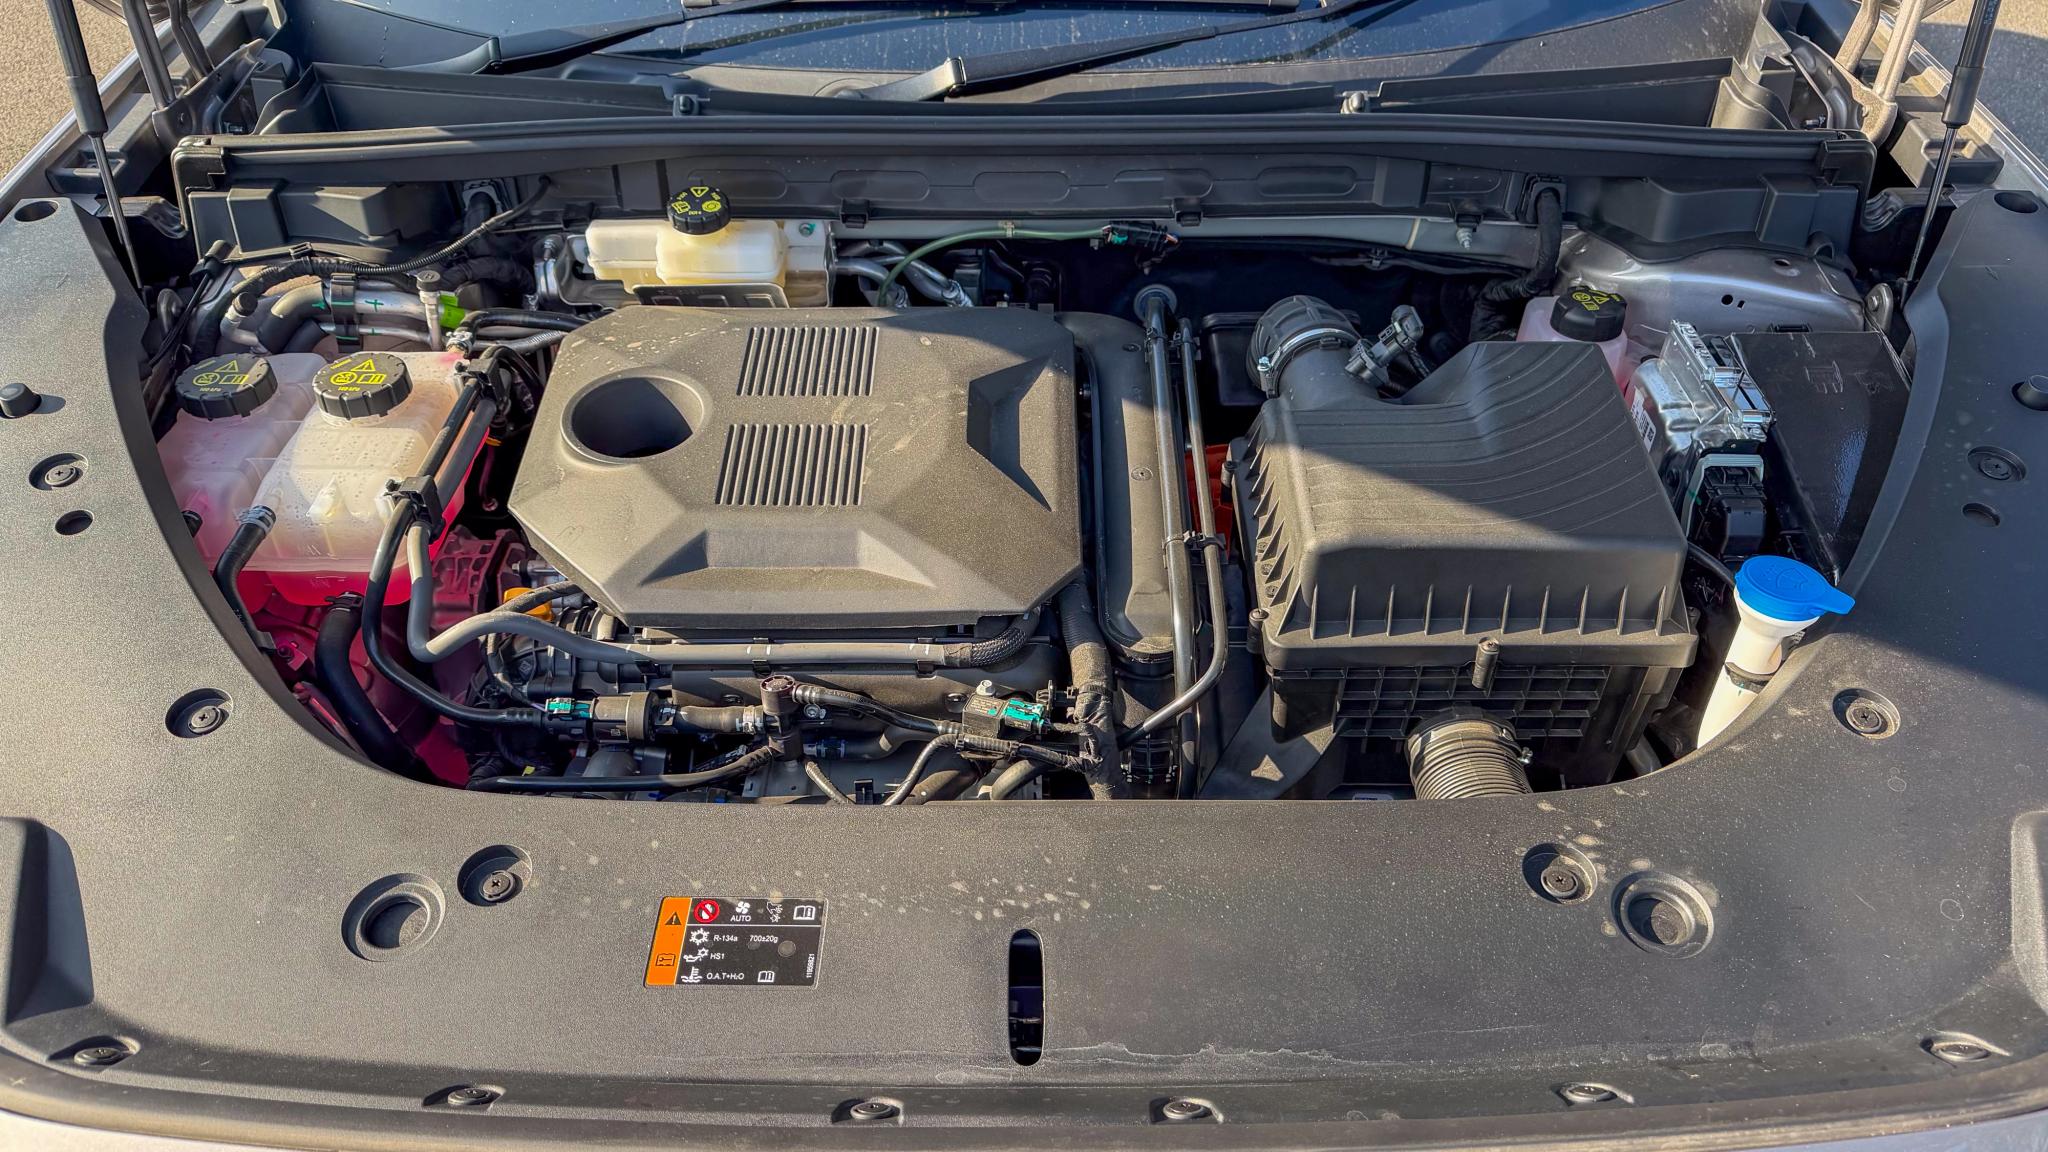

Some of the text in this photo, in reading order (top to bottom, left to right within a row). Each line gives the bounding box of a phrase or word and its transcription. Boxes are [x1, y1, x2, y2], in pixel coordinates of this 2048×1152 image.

[730, 914, 752, 922] AUTO
[713, 934, 779, 944] R-134a 700±20g
